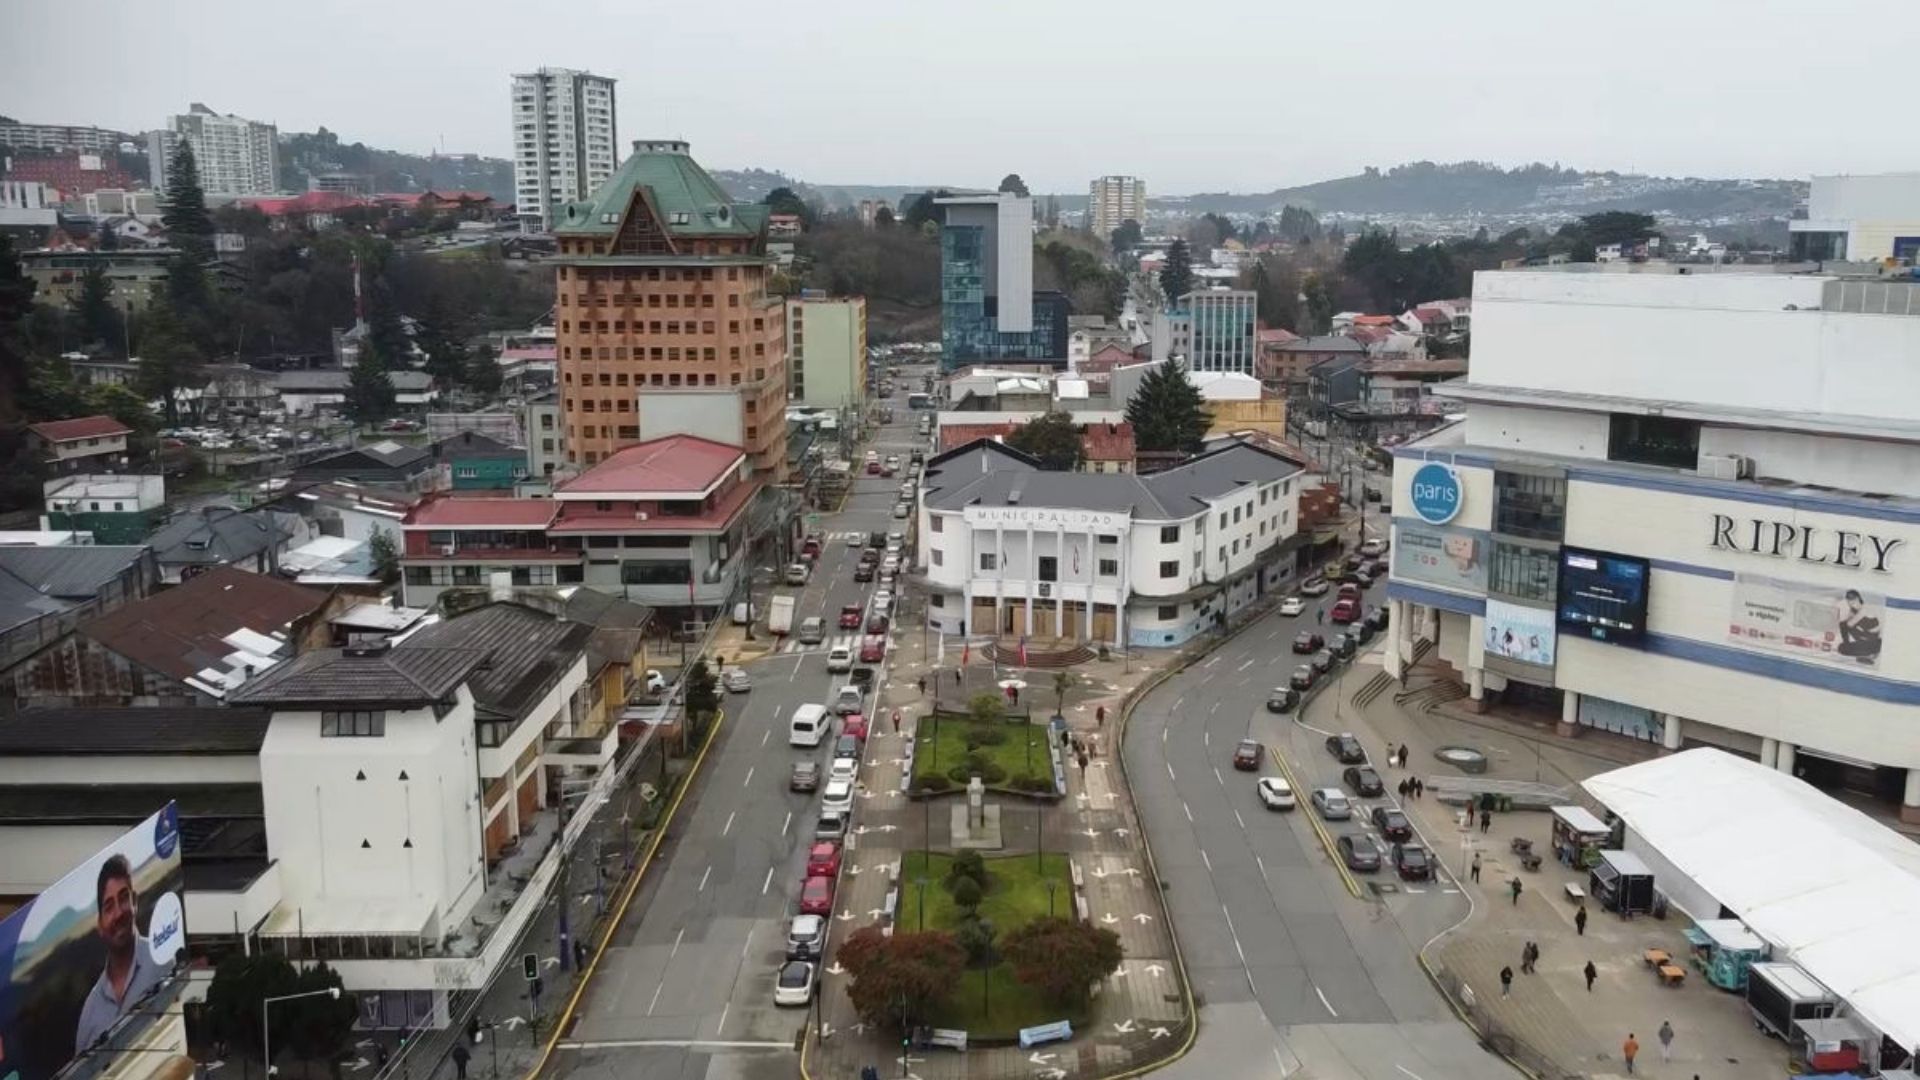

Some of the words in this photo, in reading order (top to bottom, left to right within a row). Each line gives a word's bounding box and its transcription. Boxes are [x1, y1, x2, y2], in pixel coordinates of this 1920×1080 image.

[1414, 482, 1455, 502] paris
[977, 511, 1112, 525] MUNICIPALIDAD
[1712, 514, 1901, 572] RIPLEY
